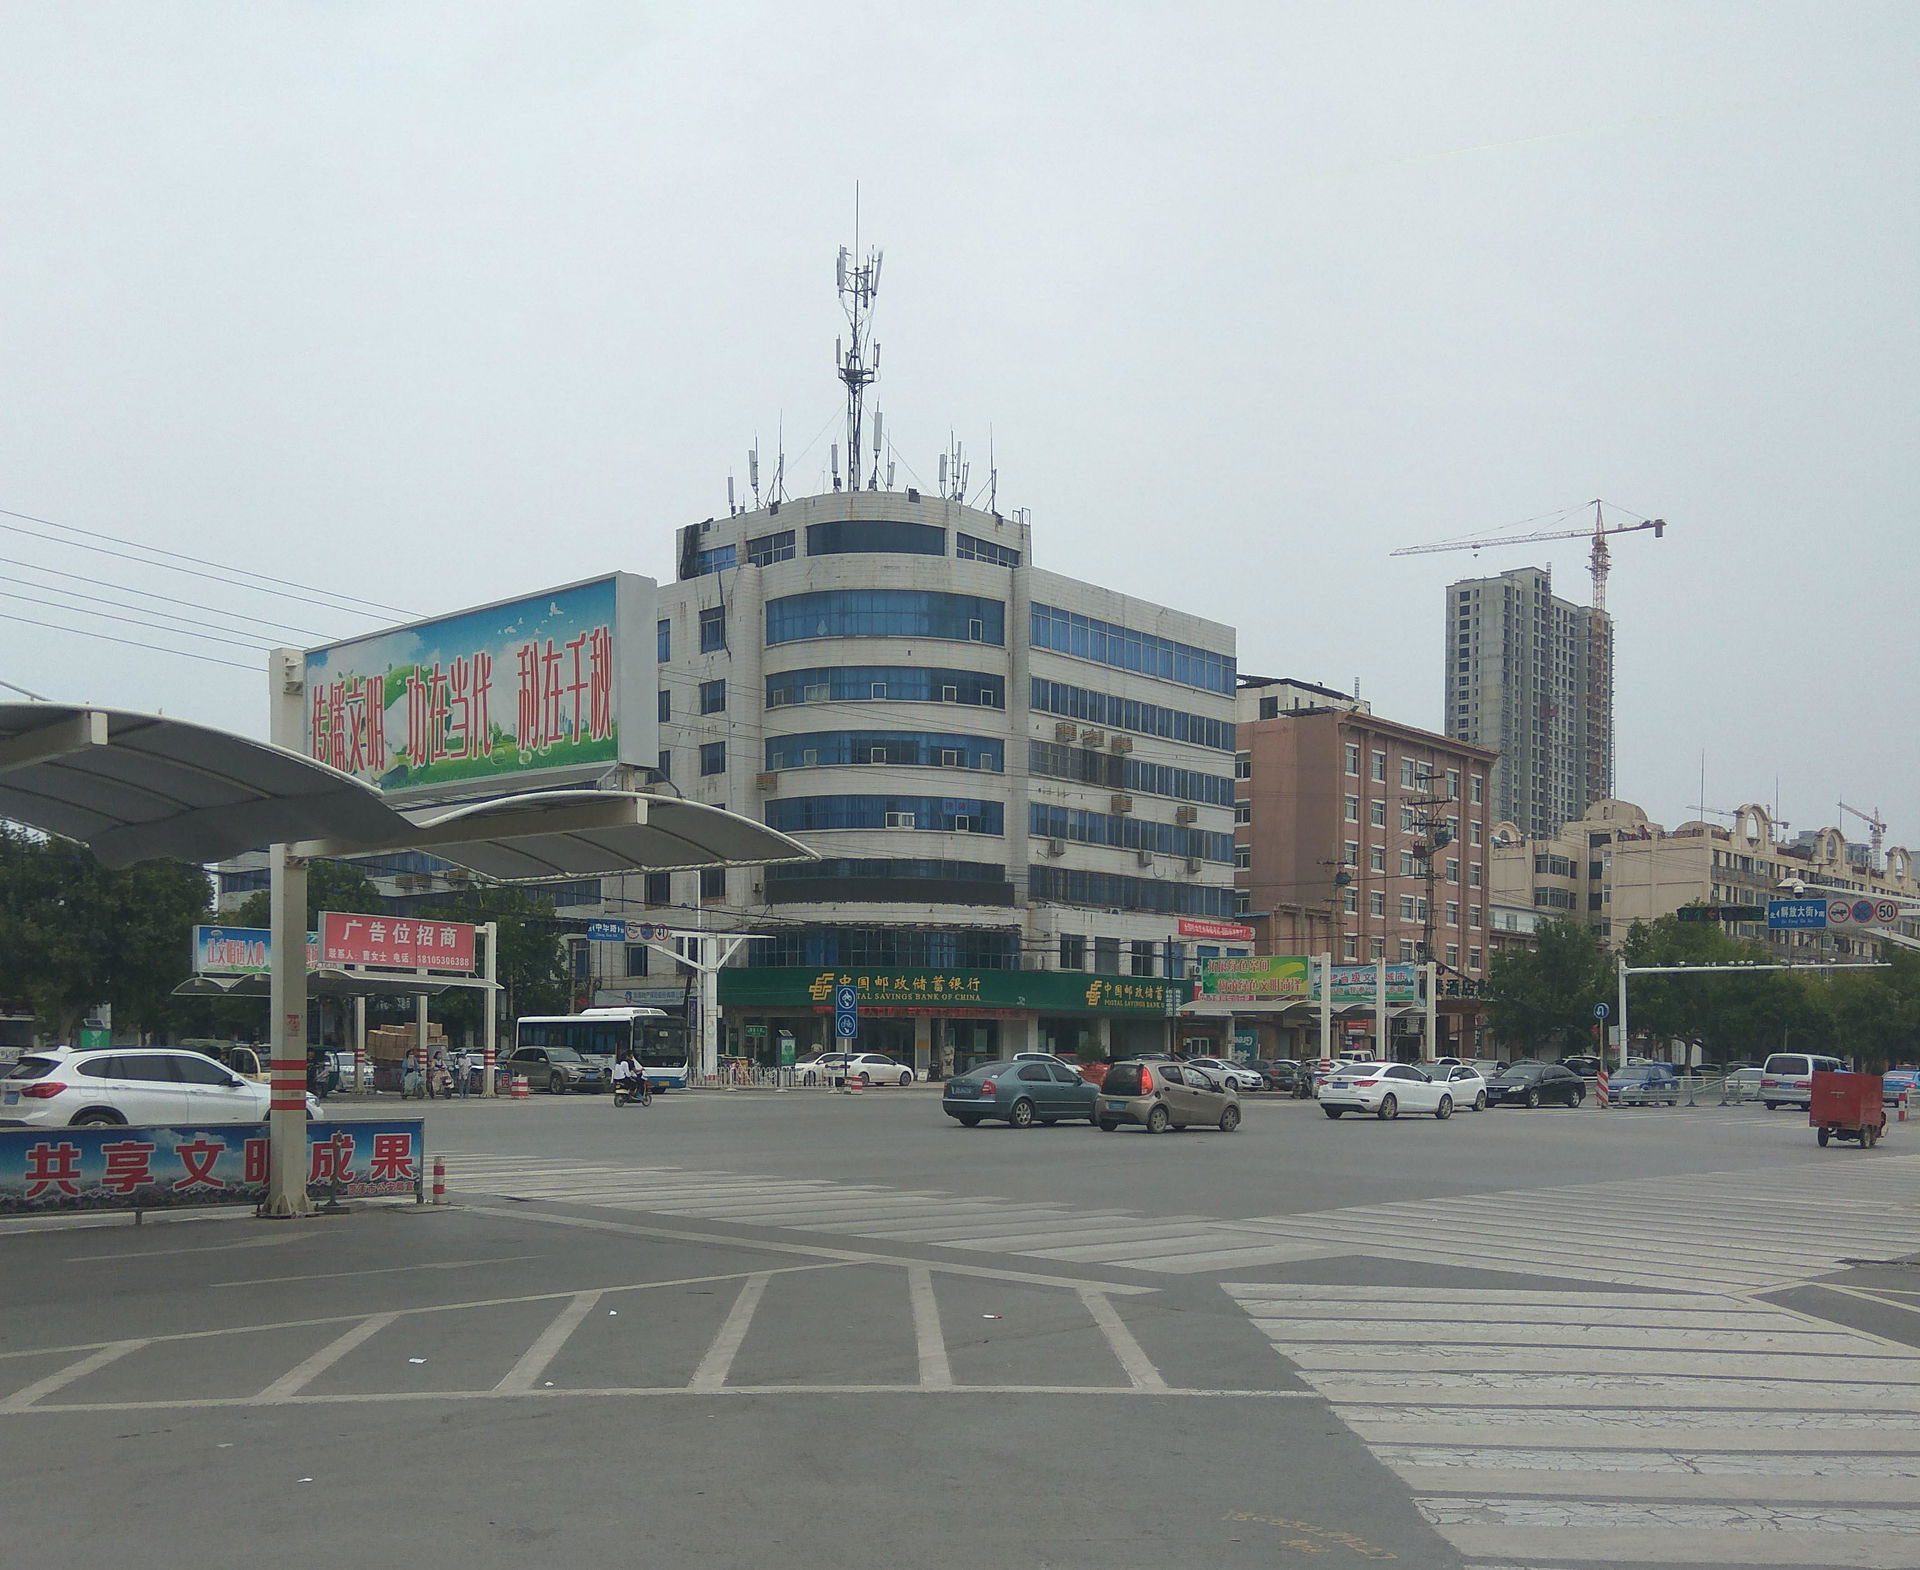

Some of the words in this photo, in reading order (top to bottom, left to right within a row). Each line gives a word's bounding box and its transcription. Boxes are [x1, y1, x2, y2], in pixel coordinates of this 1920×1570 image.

[311, 674, 386, 773] 传播文明
[406, 650, 493, 768] 功在当代
[516, 625, 613, 751] 利在千秋
[1780, 905, 1815, 918] 解放大街
[1879, 905, 1894, 918] 50
[343, 919, 458, 948] 广告位招商
[839, 974, 981, 993] 中国邮政储蓄银行
[1104, 981, 1165, 1001] 中国邮政储蓄
[874, 992, 913, 1000] SAVINGS
[915, 993, 939, 1001] BANK
[942, 993, 953, 1001] OF
[955, 993, 981, 1001] CHINA
[25, 1133, 413, 1199] 共享文明成果
